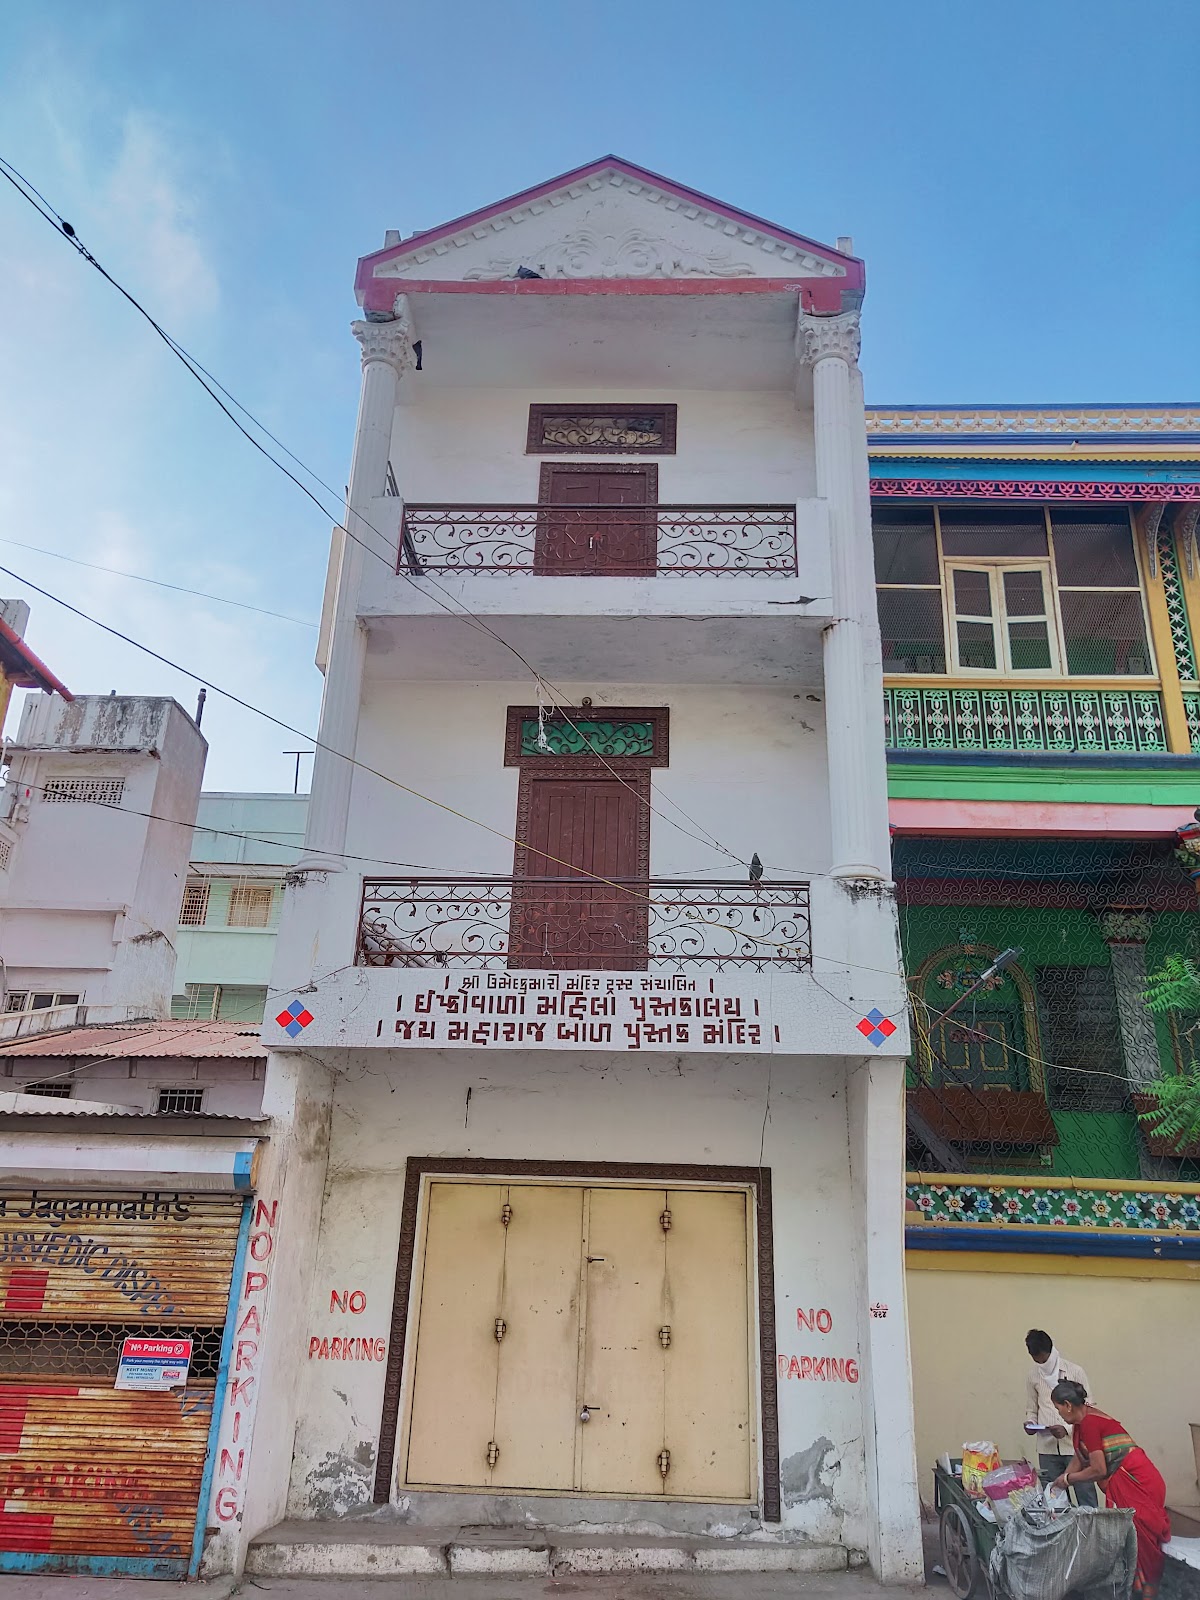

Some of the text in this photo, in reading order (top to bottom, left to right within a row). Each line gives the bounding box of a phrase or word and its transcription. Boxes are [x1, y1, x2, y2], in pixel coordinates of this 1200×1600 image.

[461, 975, 480, 990] શ્રી
[566, 974, 600, 991] મંદિર
[605, 978, 633, 995] ટ્રસ્ટ
[639, 974, 696, 992] સંચાલિત
[536, 991, 616, 1021] મહિલા
[629, 996, 741, 1022] પુસ્તકાલય
[395, 1020, 436, 1040] જય
[447, 1021, 547, 1046] મહારાજ
[557, 1022, 612, 1043] બાળ
[623, 1023, 690, 1050] પુસ્તક
[702, 1018, 761, 1045] મંદિર
[330, 1289, 367, 1315] NO
[796, 1307, 833, 1334] NO
[131, 1343, 173, 1354] No Parking
[308, 1336, 386, 1362] PARKING
[777, 1354, 859, 1383] PARKING
